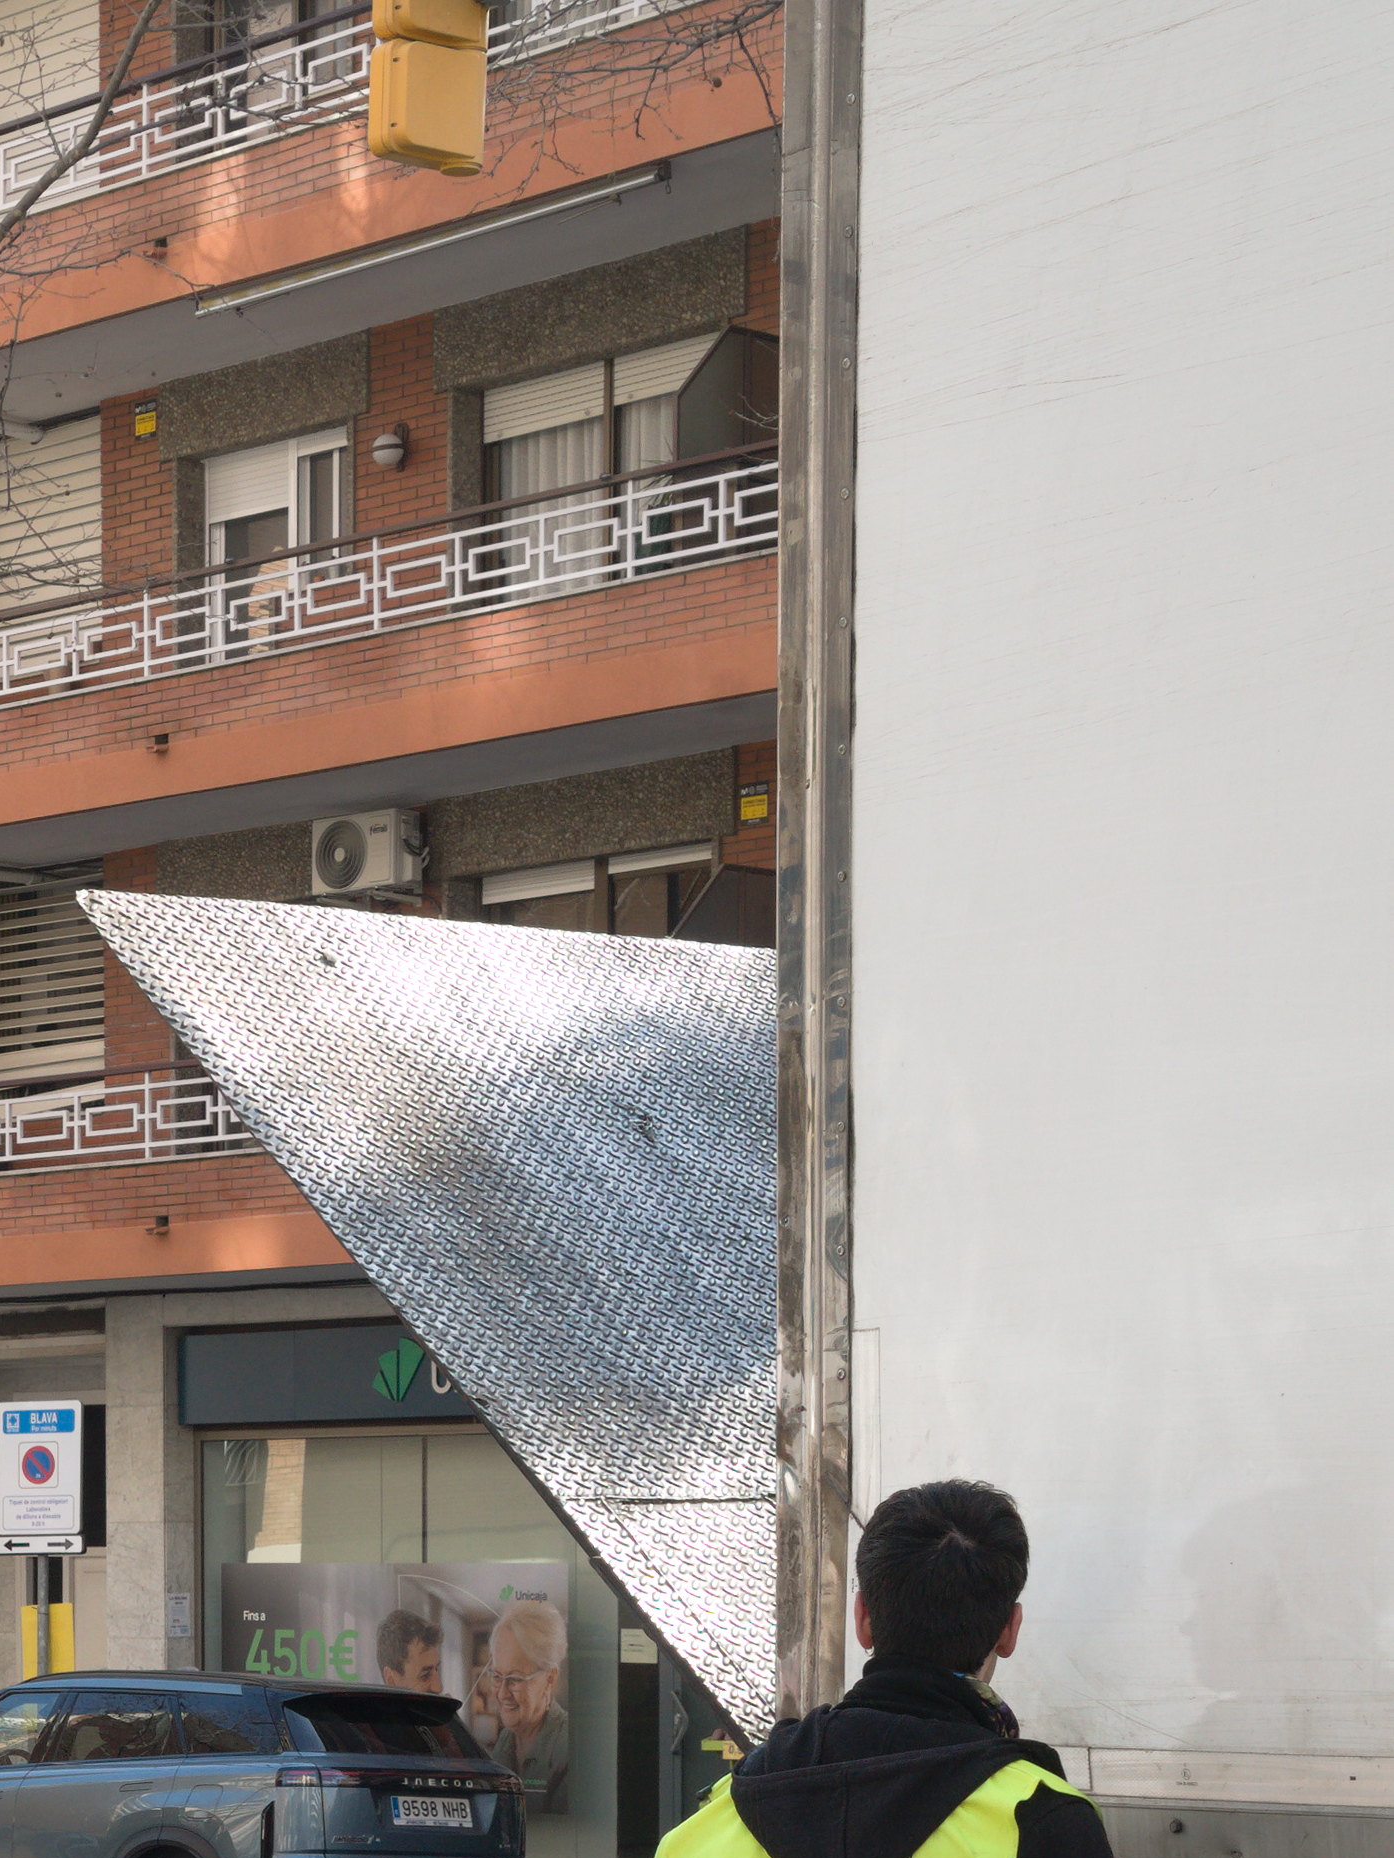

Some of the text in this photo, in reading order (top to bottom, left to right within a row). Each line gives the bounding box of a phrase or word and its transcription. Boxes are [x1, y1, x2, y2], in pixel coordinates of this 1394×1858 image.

[30, 1412, 58, 1424] BLAVA
[515, 1590, 548, 1603] Unicaja
[243, 1610, 266, 1622] Fins a
[245, 1628, 360, 1682] 450€
[402, 1800, 468, 1819] 9598 NHB
